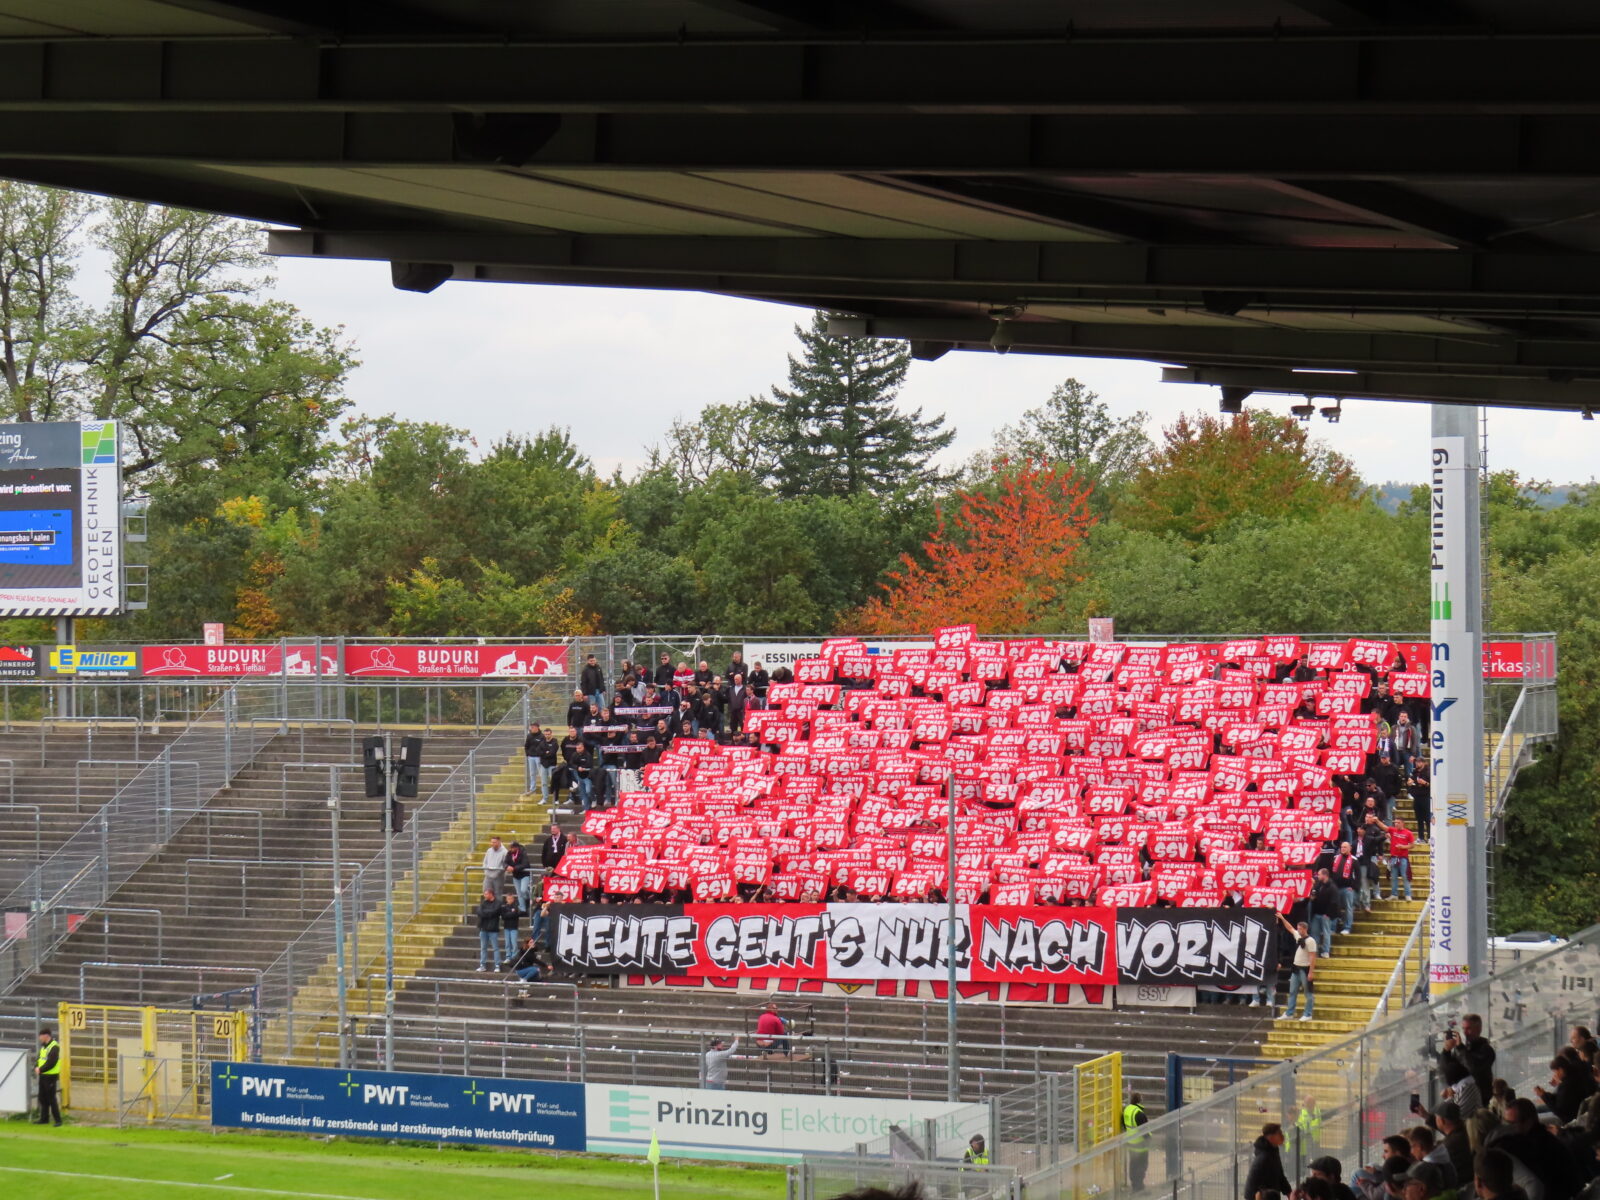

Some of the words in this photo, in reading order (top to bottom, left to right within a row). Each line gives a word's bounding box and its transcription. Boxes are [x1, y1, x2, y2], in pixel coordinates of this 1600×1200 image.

[15, 484, 54, 495] präsentiert
[1431, 448, 1449, 570] Prinzing
[88, 468, 98, 598] GEOTECHNIK
[102, 530, 113, 598] AALEN
[939, 632, 972, 648] SSV
[60, 649, 72, 664] E
[80, 652, 128, 666] Miller
[208, 649, 266, 663] BUDURI
[418, 650, 478, 664] BUDURI
[1310, 651, 1342, 666] SSV
[1352, 648, 1388, 664] SSV
[454, 664, 478, 672] Tiefbau
[798, 666, 830, 680] SSV
[843, 662, 872, 677] SSV
[976, 664, 1004, 678] SSV
[1170, 666, 1204, 681] SSV
[879, 680, 908, 696] SSV
[1393, 680, 1426, 696] SSV
[948, 688, 981, 705] SSV
[989, 696, 1022, 710] SSV
[1042, 690, 1074, 704] SSV
[1220, 692, 1253, 707] SSV
[1264, 691, 1297, 705] SSV
[1320, 698, 1354, 714] SSV
[875, 716, 905, 730] SSV
[952, 717, 982, 733] SSV
[765, 728, 798, 741] SSV
[916, 724, 948, 740] SSV
[1227, 729, 1260, 743] SSV
[1027, 740, 1060, 754] SSV
[1089, 741, 1123, 756] SSV
[1281, 734, 1316, 748] SSV
[1336, 736, 1372, 752] SSV
[828, 761, 860, 775] SSV
[1169, 752, 1204, 768] SSV
[1326, 756, 1360, 772] SSV
[649, 770, 680, 784] SSV
[774, 762, 806, 776] SSV
[832, 782, 864, 798] SSV
[1262, 778, 1298, 794] SSV
[1090, 797, 1123, 812] SSV
[1299, 796, 1335, 812] SSV
[814, 830, 844, 845] SSV
[1055, 831, 1091, 848] SSV
[1266, 828, 1302, 844] SSV
[912, 841, 944, 857] SSV
[1154, 842, 1188, 858] SSV
[733, 865, 766, 881] SSV
[1222, 871, 1260, 888] SSV
[609, 876, 640, 891] SSV
[696, 880, 730, 898] SSV
[854, 877, 887, 893] SSV
[995, 890, 1029, 906] SSV
[1439, 896, 1451, 951] Aalen
[556, 914, 698, 968] HEUTE
[705, 911, 866, 970] GEHT'S
[874, 916, 972, 970] NUR
[981, 916, 1106, 976] NACH
[1115, 915, 1270, 981] VORN!
[1138, 986, 1170, 1000] SSV
[71, 1011, 82, 1027] 19
[216, 1020, 230, 1036] 20
[242, 1076, 286, 1098] PWT
[364, 1084, 408, 1106] PWT
[490, 1092, 536, 1114] PWT
[657, 1100, 768, 1136] Prinzing
[242, 1112, 254, 1122] Ihr
[256, 1112, 310, 1126] Dienstleister
[312, 1116, 326, 1128] für
[328, 1118, 378, 1131] zerstörende
[381, 1122, 398, 1132] und
[400, 1123, 472, 1138] zerstörungsfreie
[474, 1128, 554, 1144] Werkstoffprüfung
